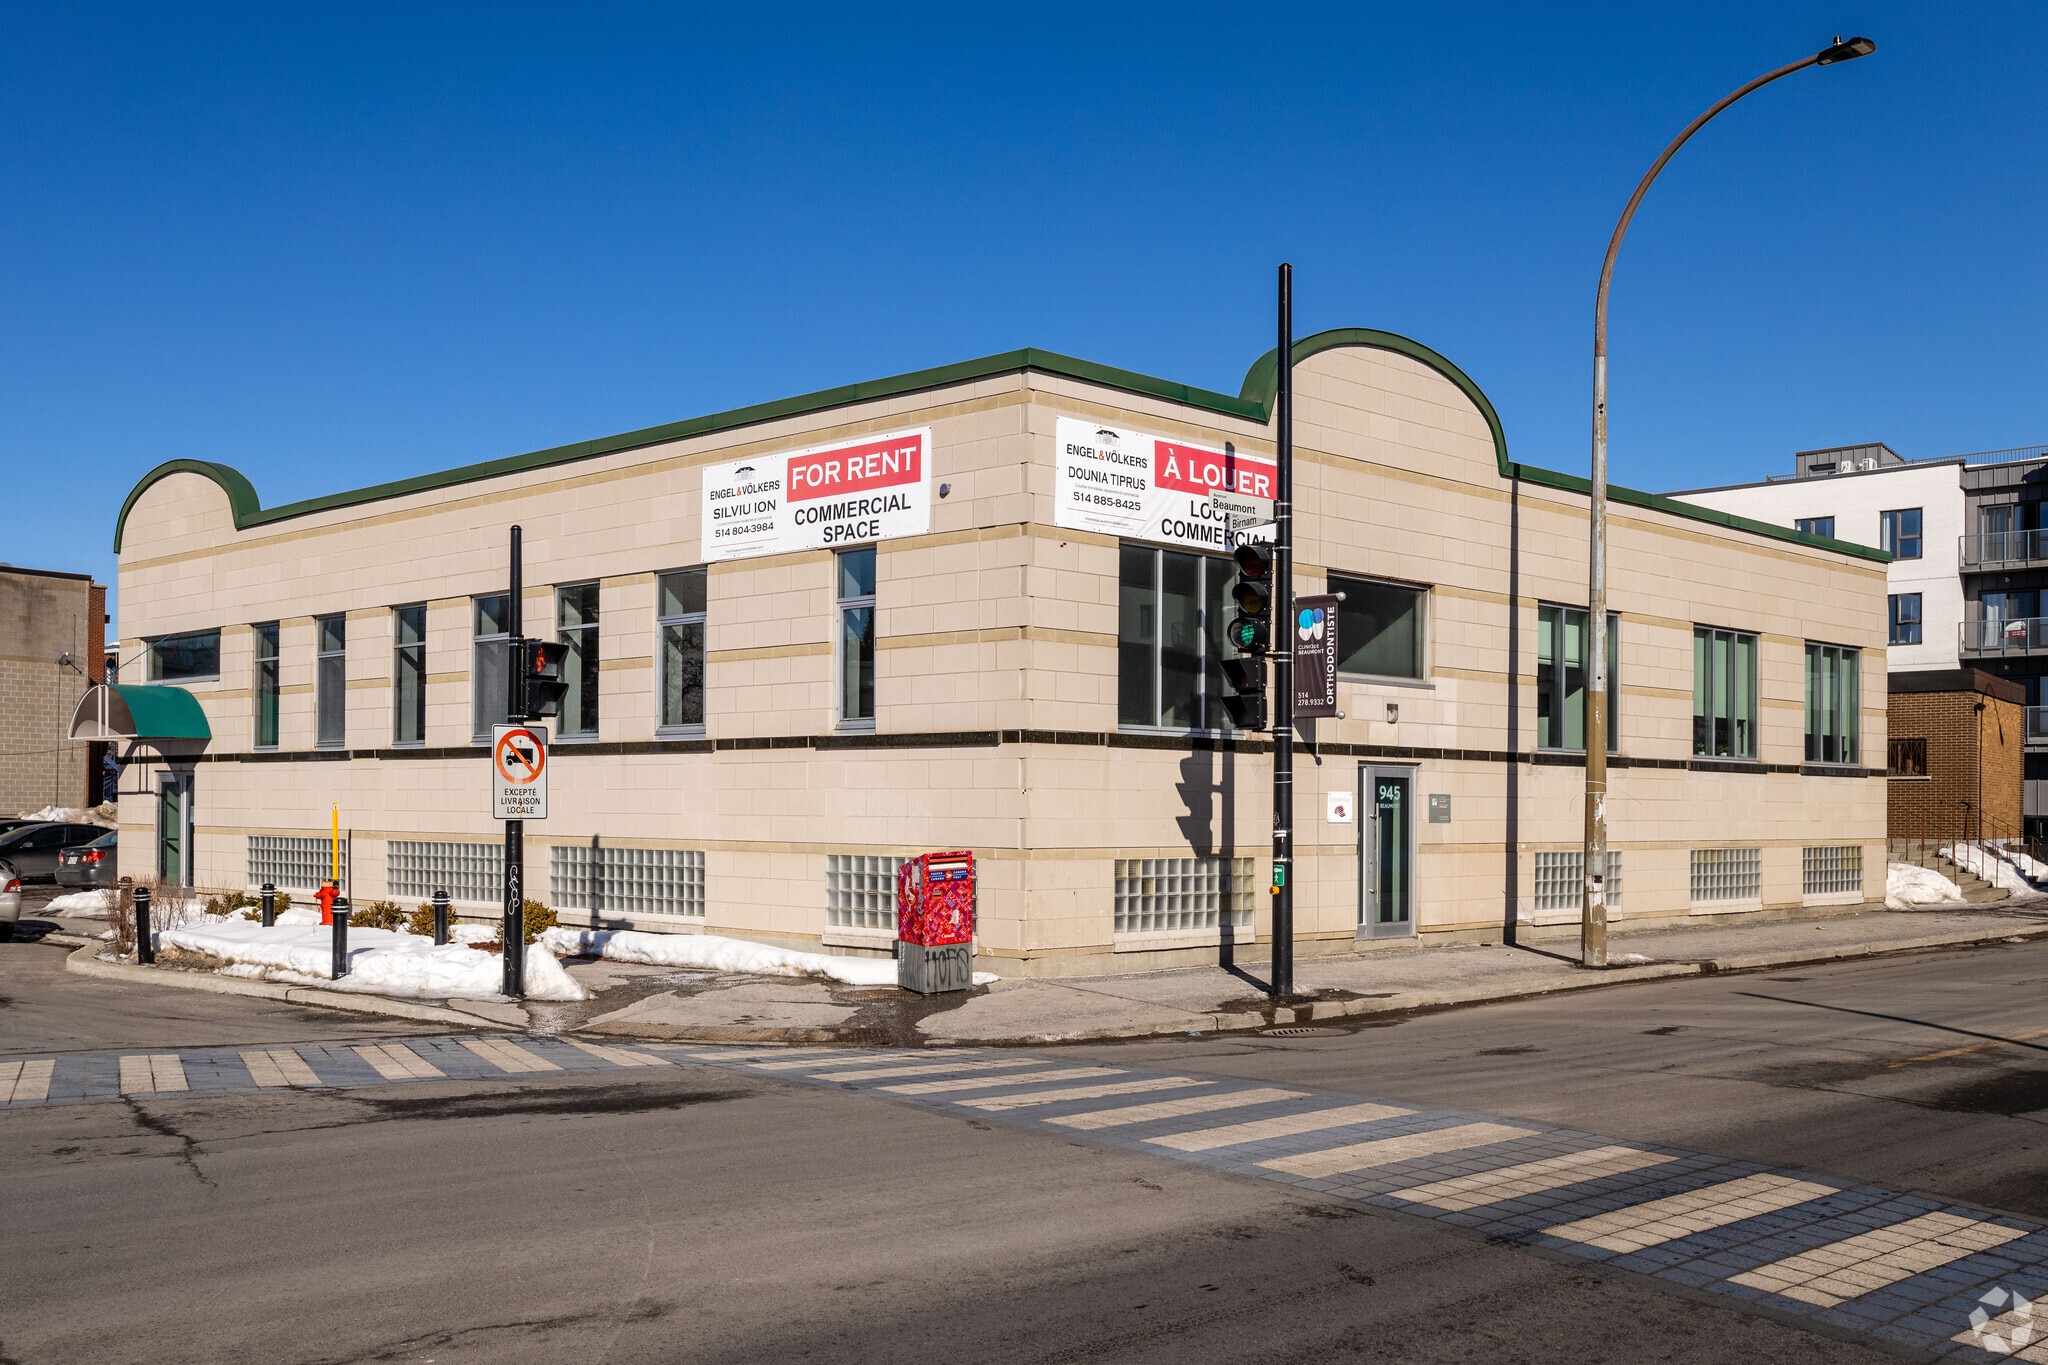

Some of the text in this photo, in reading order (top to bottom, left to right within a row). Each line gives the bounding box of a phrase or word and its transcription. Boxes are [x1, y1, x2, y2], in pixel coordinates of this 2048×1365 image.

[791, 446, 917, 490] FOR RENT
[1163, 447, 1270, 498] À LOUER
[1068, 466, 1108, 485] DOUNIA
[1110, 473, 1146, 491] TIPRUS
[713, 499, 776, 520] SILVIU ION
[794, 493, 911, 526] COMMERCIAL
[1073, 492, 1141, 511] 514 885-8425
[1213, 498, 1256, 515] Beaumont
[715, 522, 774, 538] 514 804-3984
[823, 519, 880, 543] SPACE
[1232, 517, 1257, 529] Birnam
[1326, 606, 1335, 705] ORTHODONTISTE
[500, 797, 541, 805] LIVRAISON
[504, 787, 537, 796] EXCEPTÉ
[1379, 785, 1401, 801] 945
[506, 806, 535, 814] LOCALE
